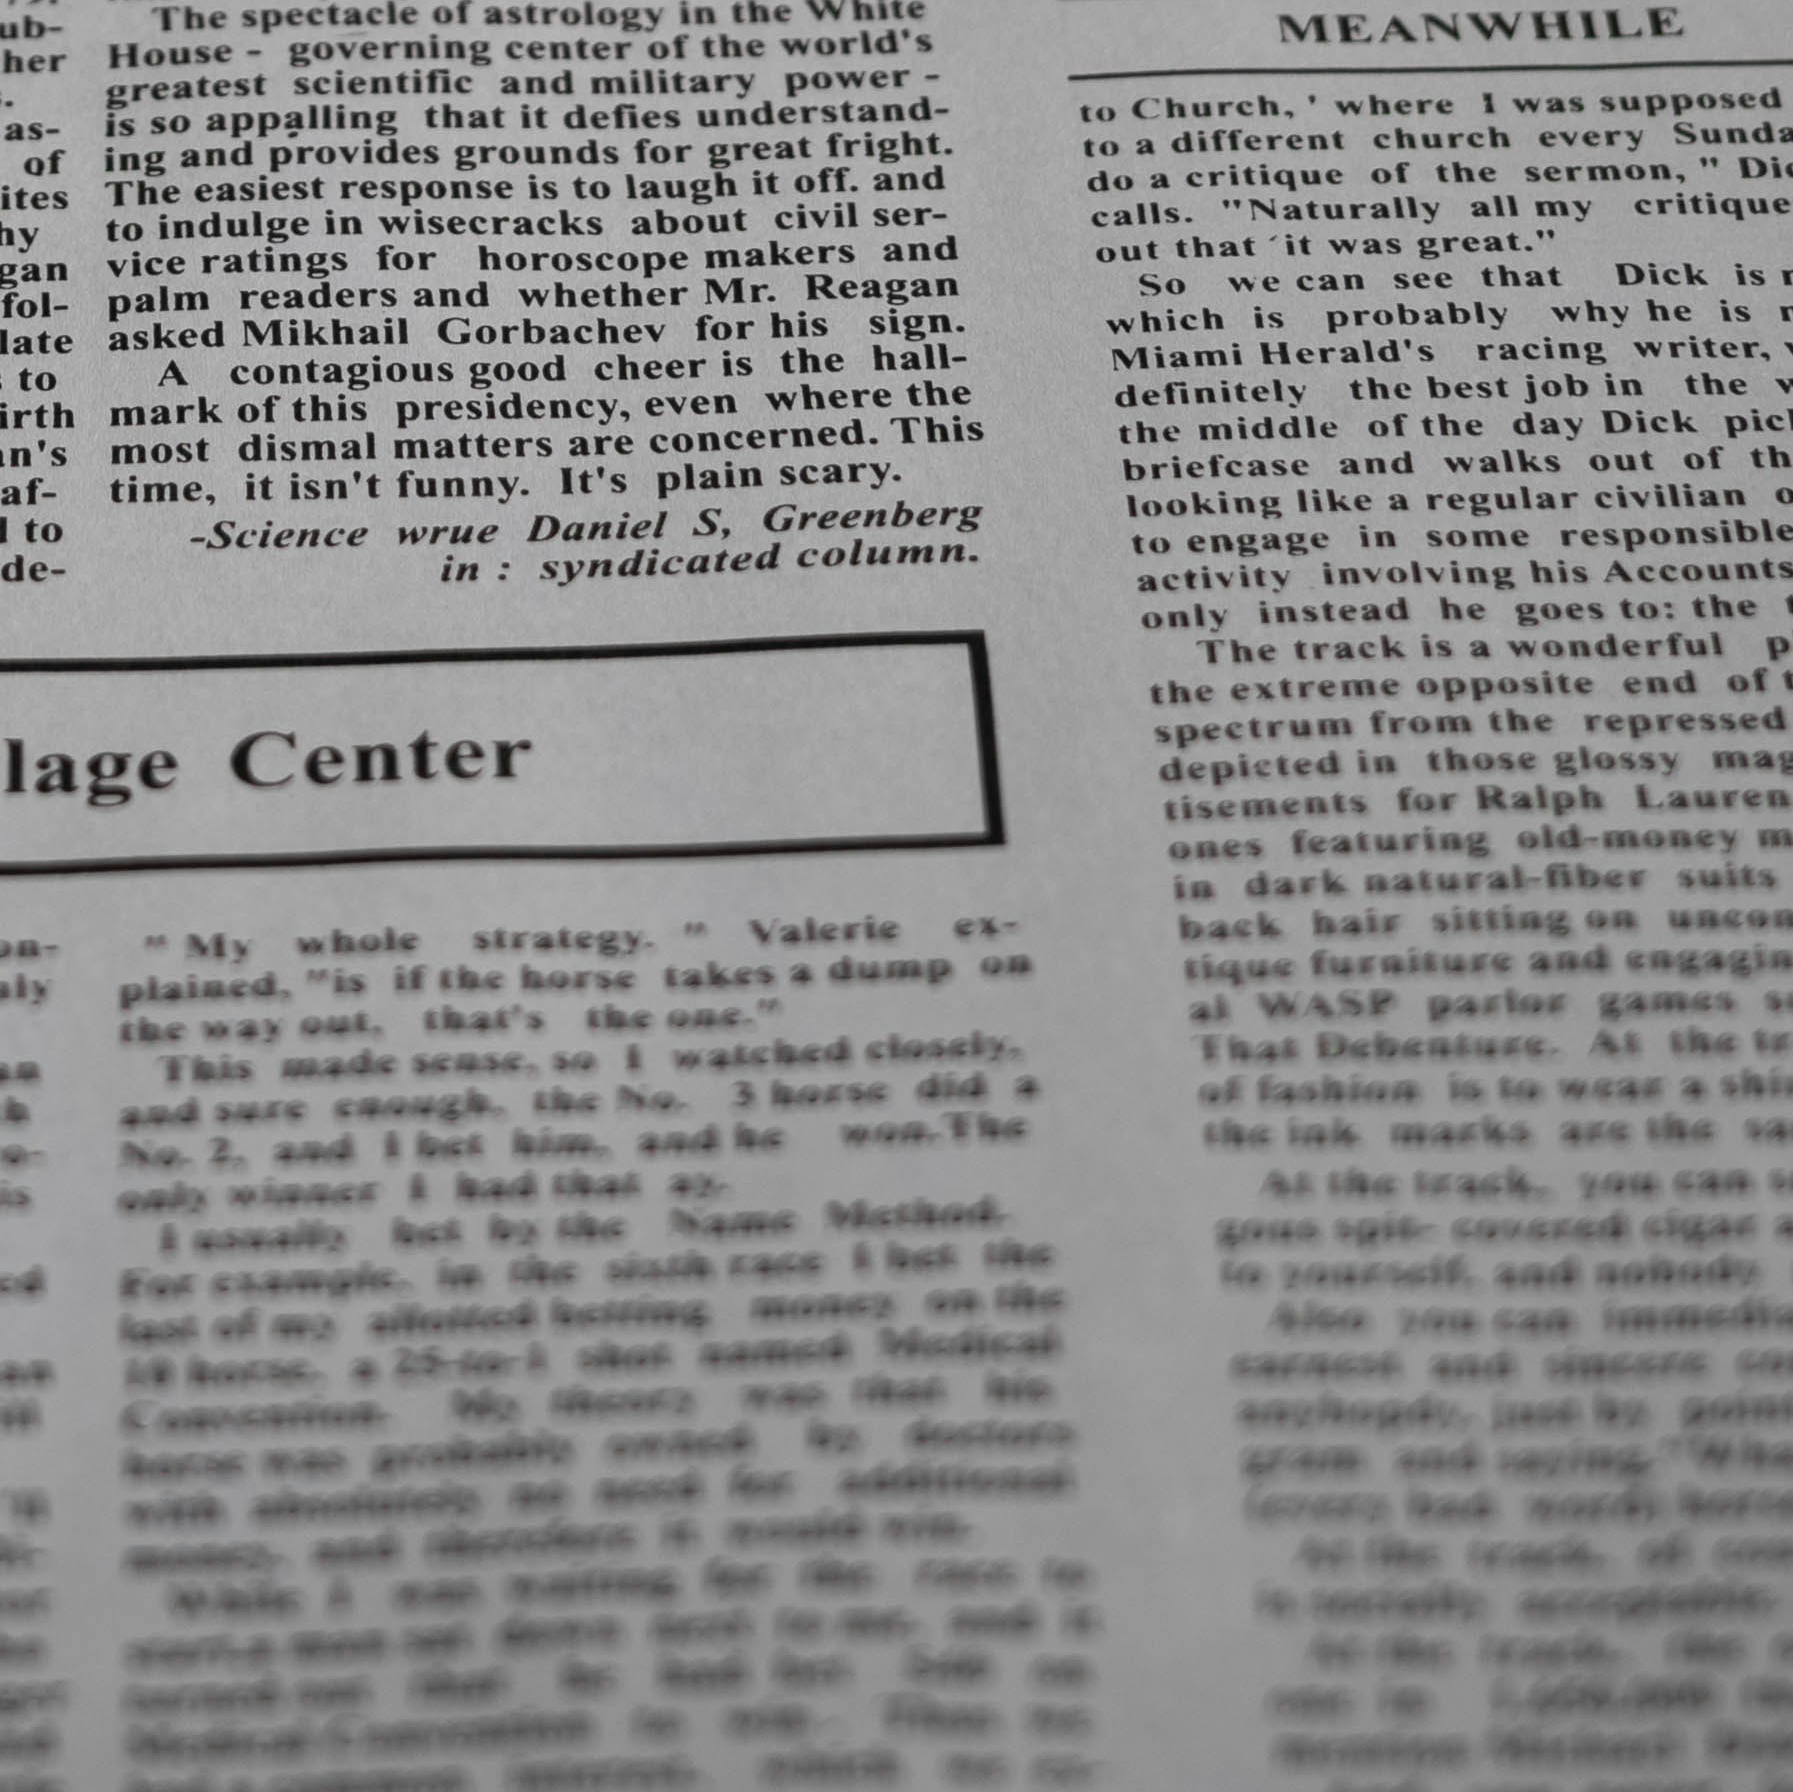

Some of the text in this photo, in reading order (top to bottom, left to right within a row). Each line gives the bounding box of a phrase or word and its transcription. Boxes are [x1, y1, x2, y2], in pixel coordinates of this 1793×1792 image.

[1279, 7, 1685, 44] MEANWHILE
[1079, 104, 1117, 124] to
[1335, 94, 1455, 116] where
[1512, 96, 1585, 114] was
[1599, 86, 1783, 118] supposed
[1095, 240, 1159, 264] out
[1175, 235, 1256, 259] that
[1327, 237, 1402, 256] was
[1416, 228, 1556, 261] great."
[157, 342, 968, 392] A contagious good cheer is the hall-
[109, 379, 972, 430] mark of this presidency, even where the
[110, 416, 985, 465] most dismal matters are concerned. This
[0, 477, 57, 506] af-
[109, 460, 902, 506] time, it isn't funny. It's plain scary.
[24, 518, 63, 544] to
[398, 524, 500, 546] wrue
[526, 510, 668, 543] Daniel
[762, 499, 984, 534] Greenberg
[0, 553, 68, 582] de-
[440, 554, 480, 583] in
[539, 541, 782, 588] syndicated
[796, 538, 980, 568] column.
[1137, 564, 1290, 594] activity
[1322, 560, 1516, 591] involving
[1529, 559, 1589, 584] his
[1154, 705, 1788, 750] spectrum from the repressed
[229, 729, 533, 789] Center
[1397, 787, 1457, 812] for
[1477, 784, 1604, 817] Ralph
[1636, 784, 1791, 810] Lauren
